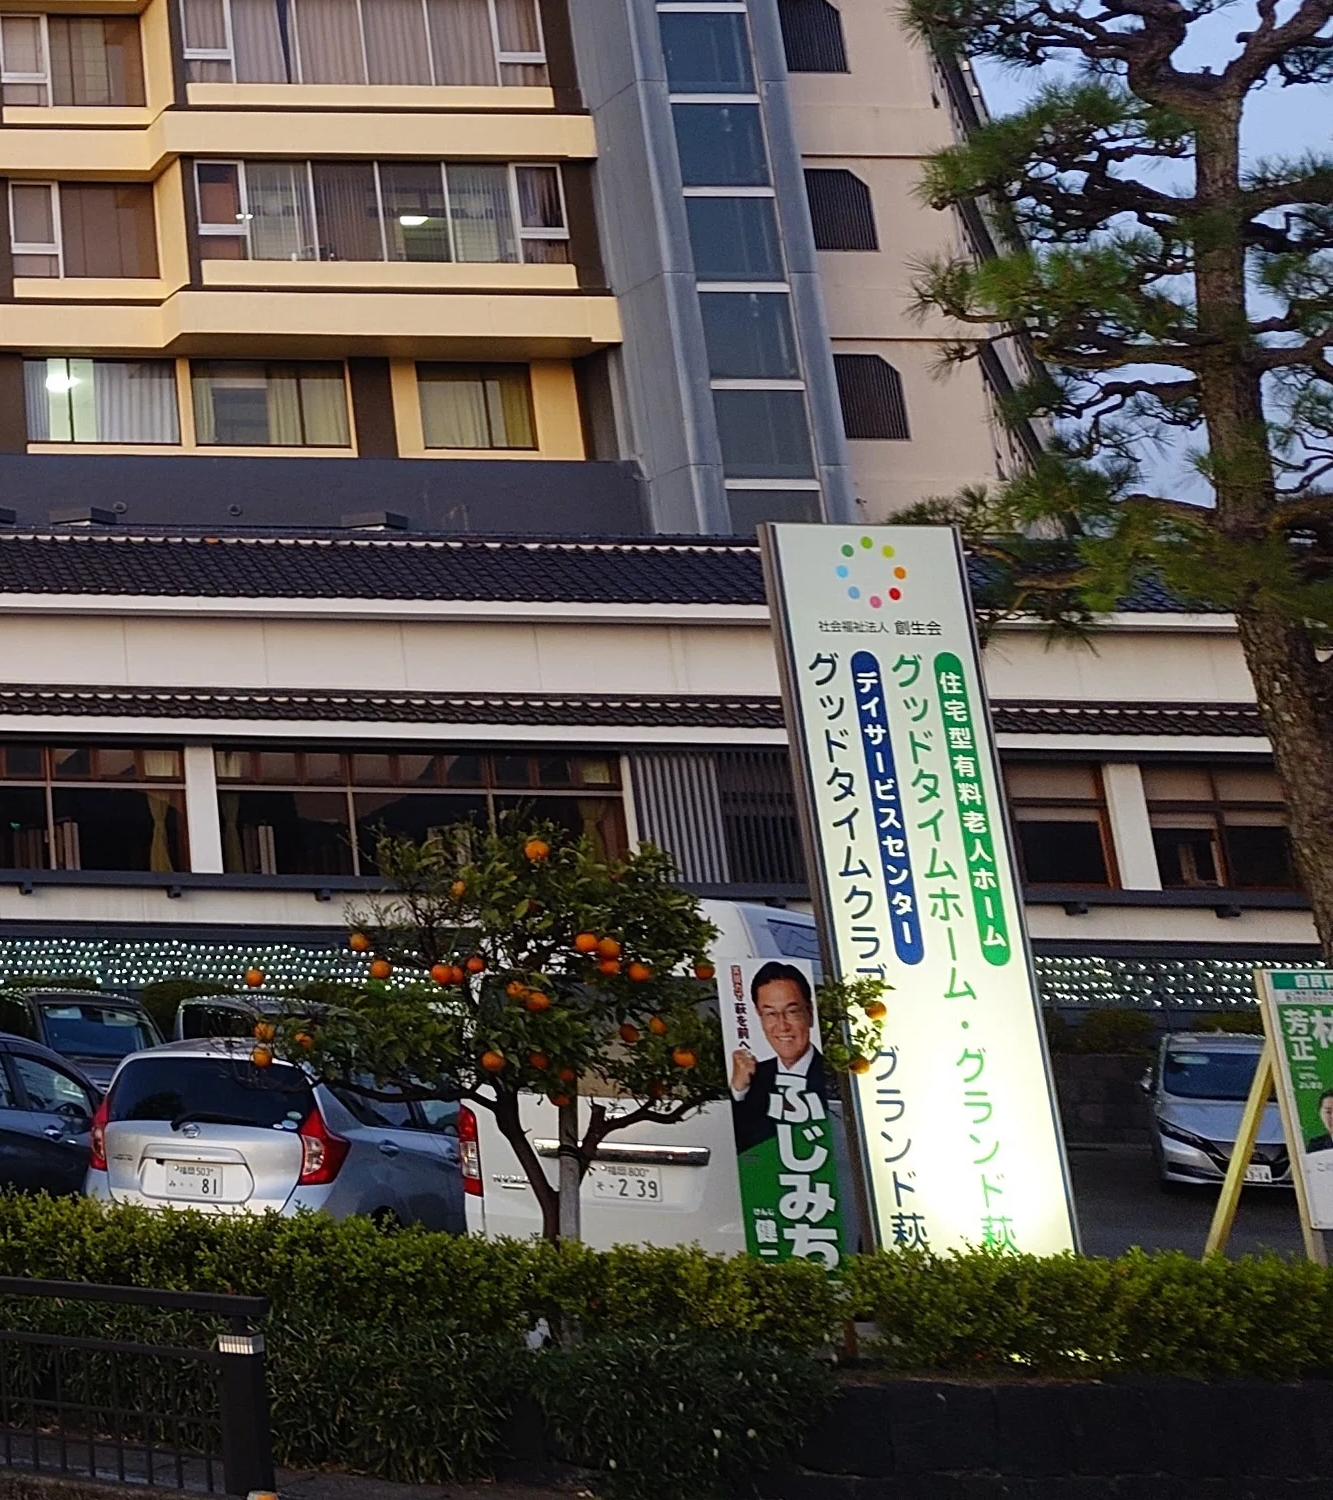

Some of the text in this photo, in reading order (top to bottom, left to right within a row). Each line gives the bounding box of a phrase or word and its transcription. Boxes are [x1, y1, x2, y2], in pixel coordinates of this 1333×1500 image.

[817, 620, 942, 636] 社会福祉法人 創生会
[855, 671, 914, 944] デイサービスセンター
[939, 671, 1007, 947] 住宅型有料老人ホーム
[1283, 1008, 1318, 1061] 芳正
[196, 1166, 211, 1176] 503
[767, 1073, 840, 1272] ふじみち
